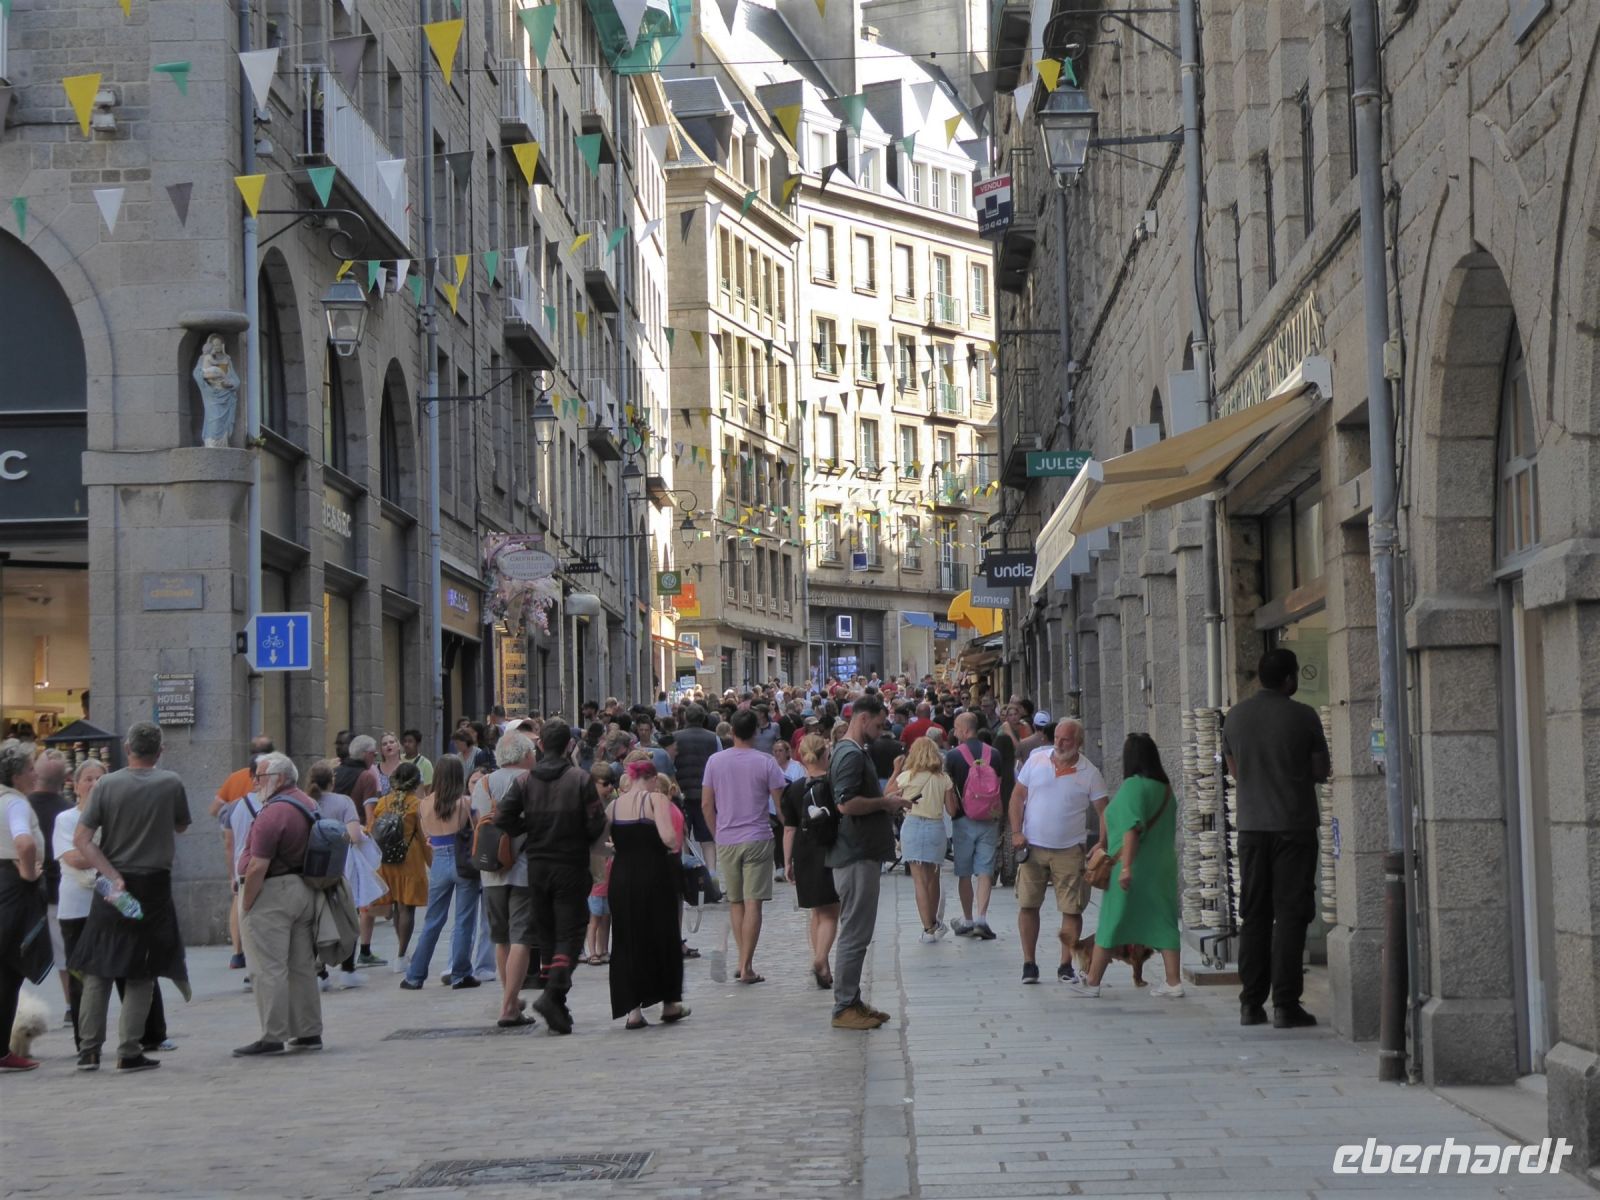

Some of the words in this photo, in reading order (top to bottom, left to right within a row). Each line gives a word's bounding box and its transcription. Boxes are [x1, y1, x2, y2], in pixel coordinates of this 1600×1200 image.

[979, 180, 1002, 192] VENDU
[1036, 457, 1084, 470] JULES
[994, 563, 1034, 578] undiz
[973, 593, 1010, 605] pimkie
[157, 694, 190, 704] HOTELS
